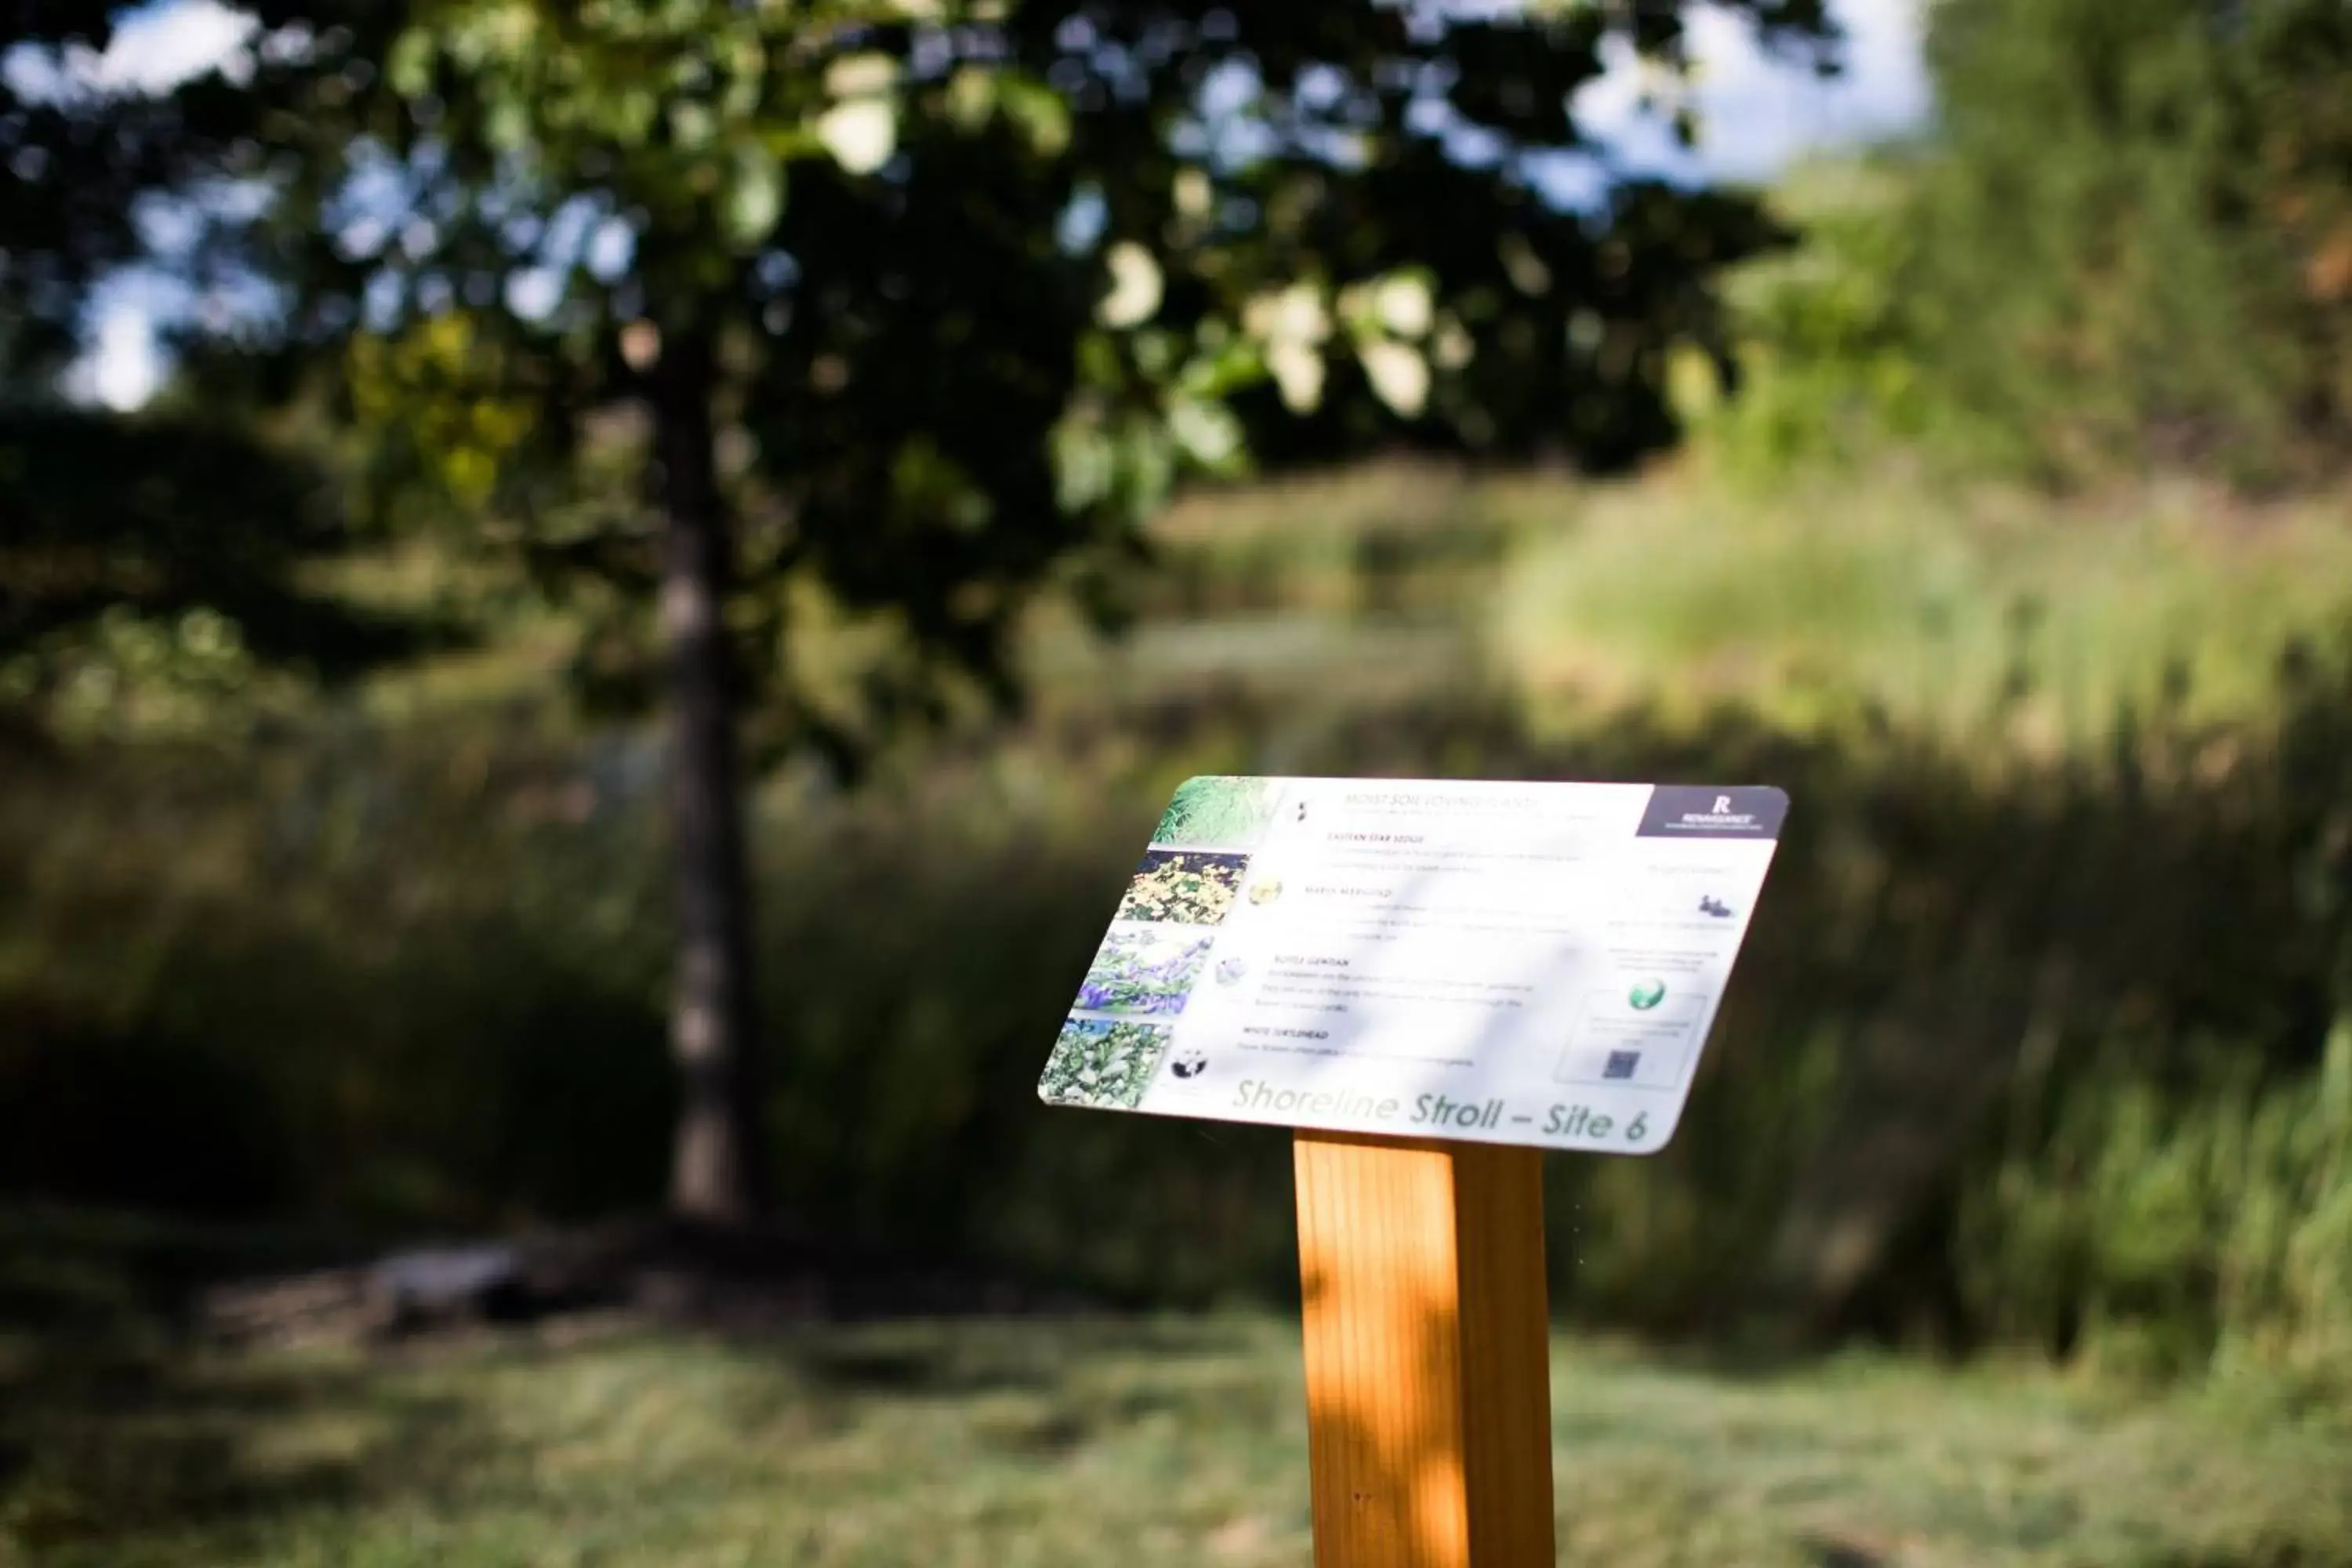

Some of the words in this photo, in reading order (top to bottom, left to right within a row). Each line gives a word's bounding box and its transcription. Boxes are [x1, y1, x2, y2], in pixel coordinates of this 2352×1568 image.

[1712, 795, 1731, 813] R
[1232, 1079, 1399, 1120] Shoreline
[1409, 1093, 1504, 1129] Stroll
[1541, 1103, 1613, 1138] Site
[1625, 1109, 1649, 1140] 6
